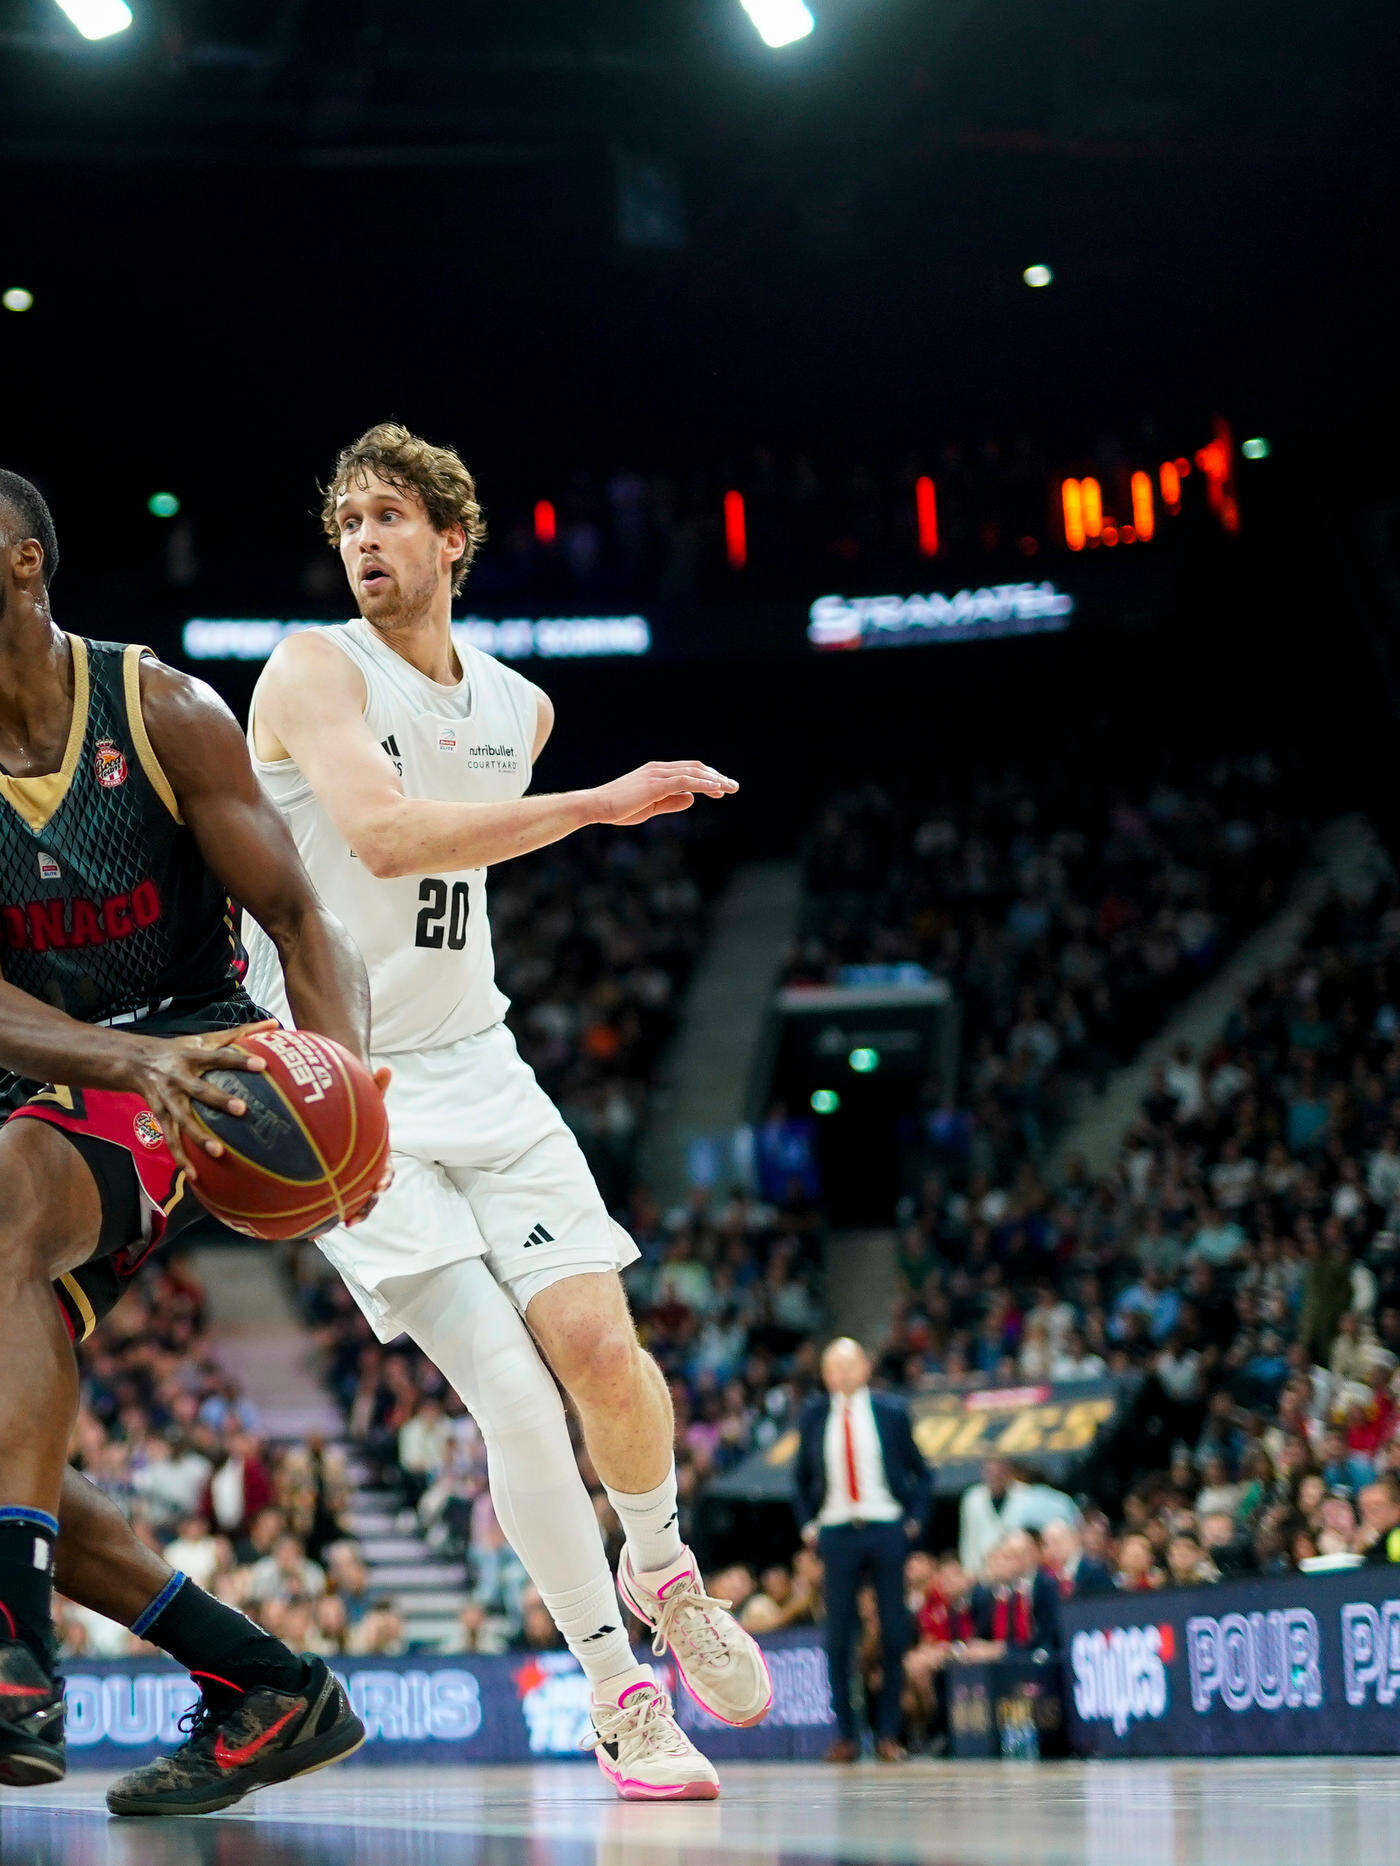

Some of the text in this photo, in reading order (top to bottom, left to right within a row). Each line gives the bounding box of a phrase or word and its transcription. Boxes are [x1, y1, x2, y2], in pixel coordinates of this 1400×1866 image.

[808, 582, 1072, 644] STRAMATEL
[467, 761, 518, 770] COURTYARD
[415, 878, 469, 951] 20
[1187, 1608, 1323, 1713] POUR
[63, 1674, 202, 1744] OUR
